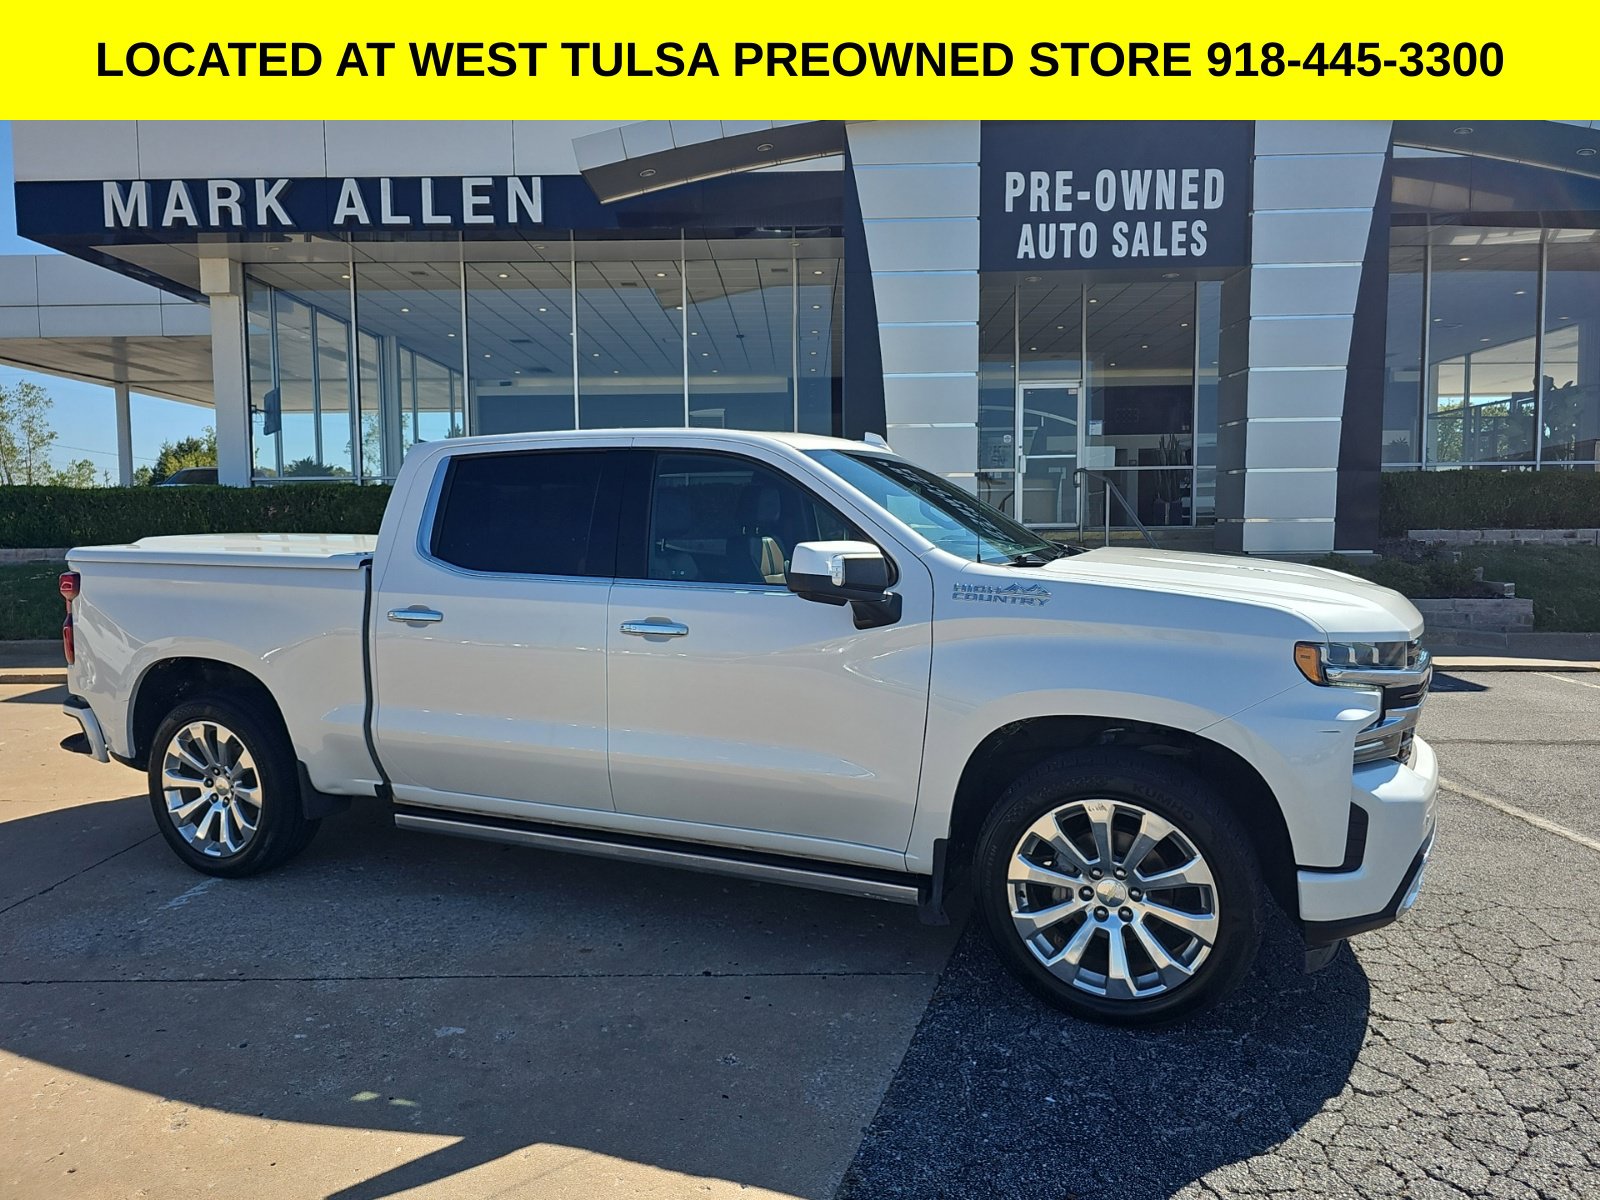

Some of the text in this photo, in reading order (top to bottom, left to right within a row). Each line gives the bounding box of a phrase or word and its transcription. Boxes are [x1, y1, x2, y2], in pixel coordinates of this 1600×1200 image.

[103, 177, 543, 227] MARK ALLEN
[1005, 169, 1225, 212] PRE-OWNED
[1016, 220, 1208, 259] AUTO SALES
[952, 592, 1050, 606] COUNTRY
[953, 583, 1002, 593] HIGH
[1133, 784, 1194, 821] KUMHO
